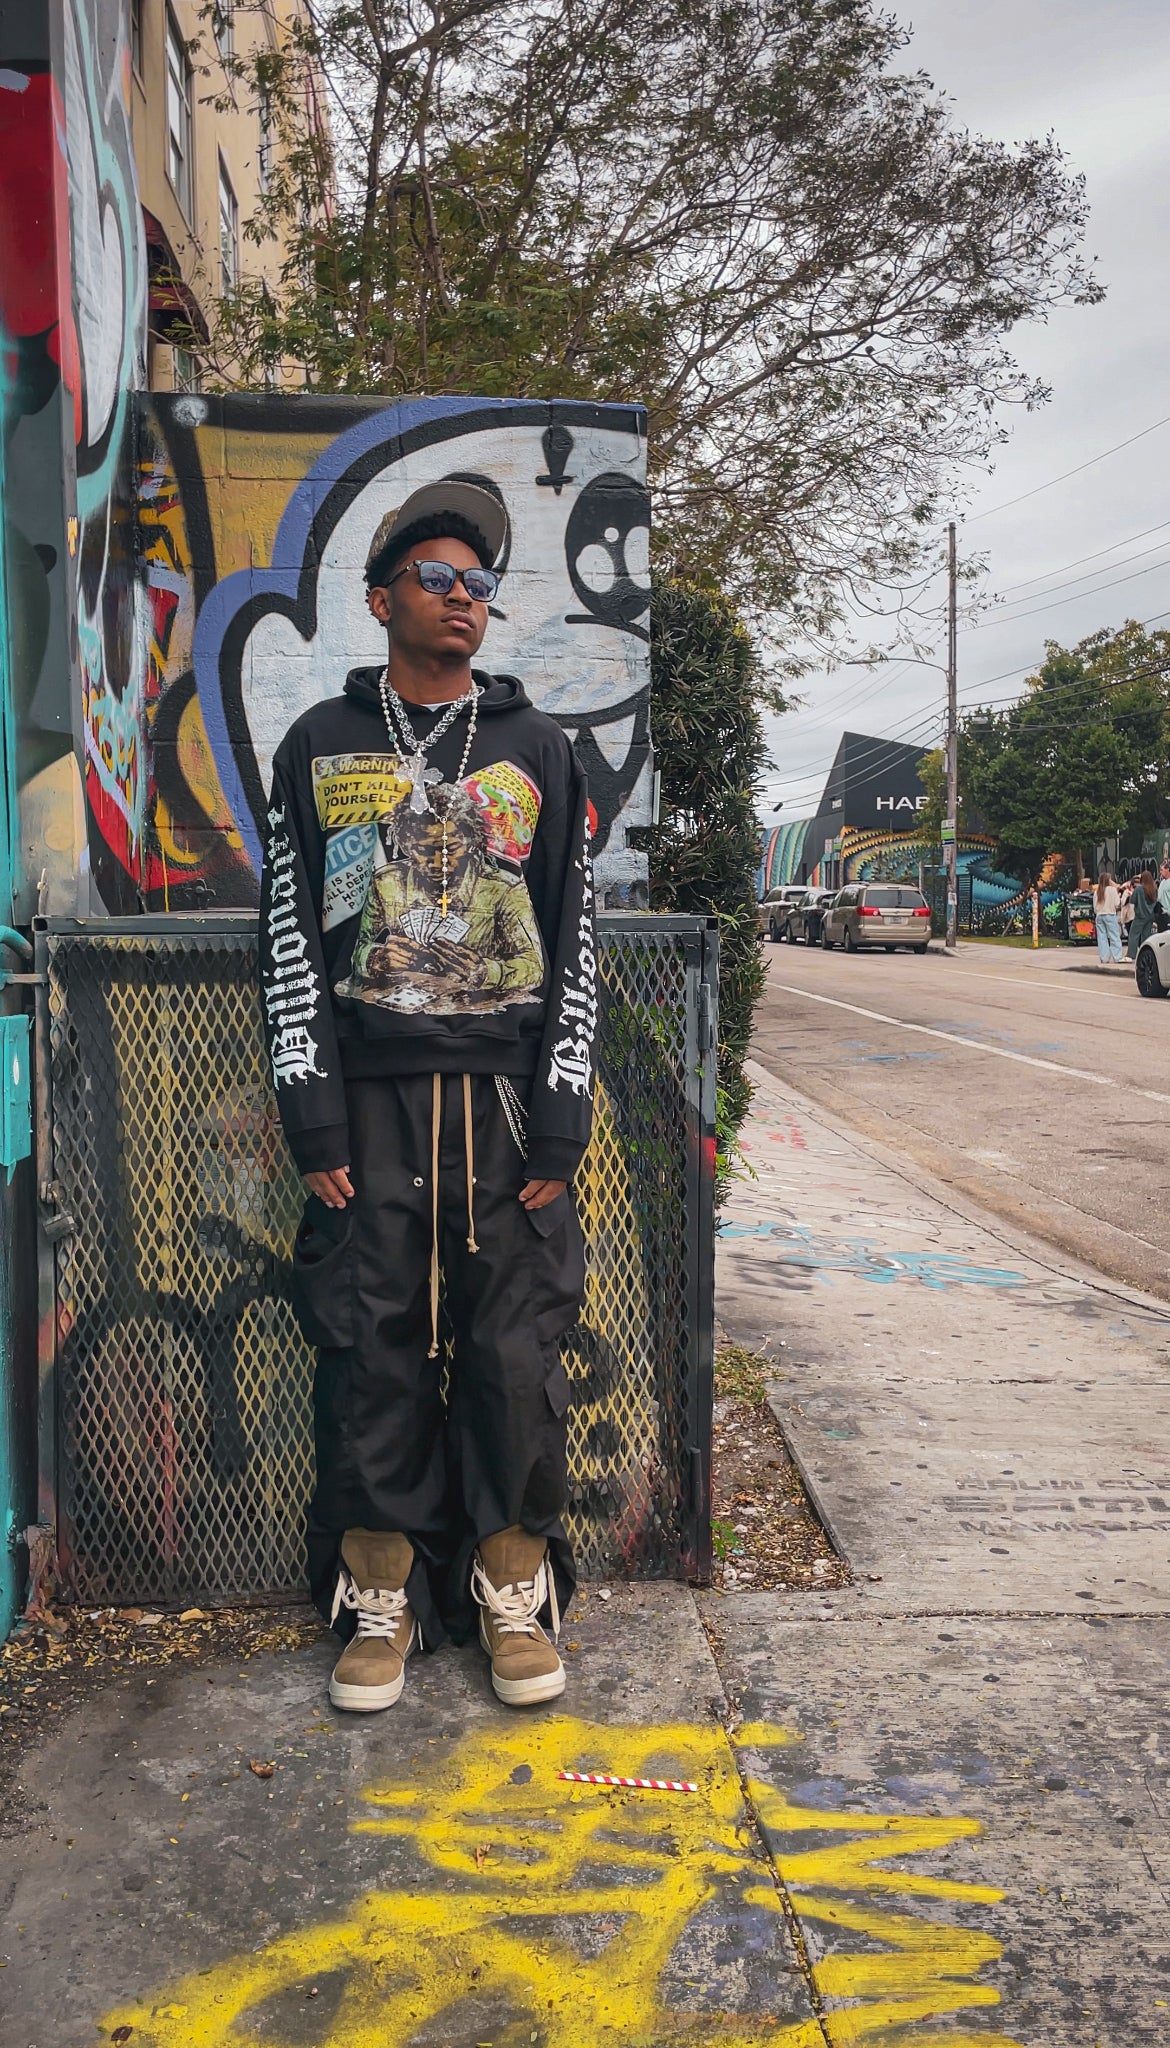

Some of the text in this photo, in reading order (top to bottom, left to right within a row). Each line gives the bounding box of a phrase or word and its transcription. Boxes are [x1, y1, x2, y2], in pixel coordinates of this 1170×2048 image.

[340, 760, 398, 771] WARNIN
[324, 781, 402, 796] DON'T KILL
[325, 793, 398, 808] YOURSELF
[326, 824, 374, 870] TICE
[327, 867, 375, 902] ALL DEPE
[331, 876, 342, 887] IS
[342, 885, 364, 902] HOW
[263, 802, 328, 1090] Billionaire
